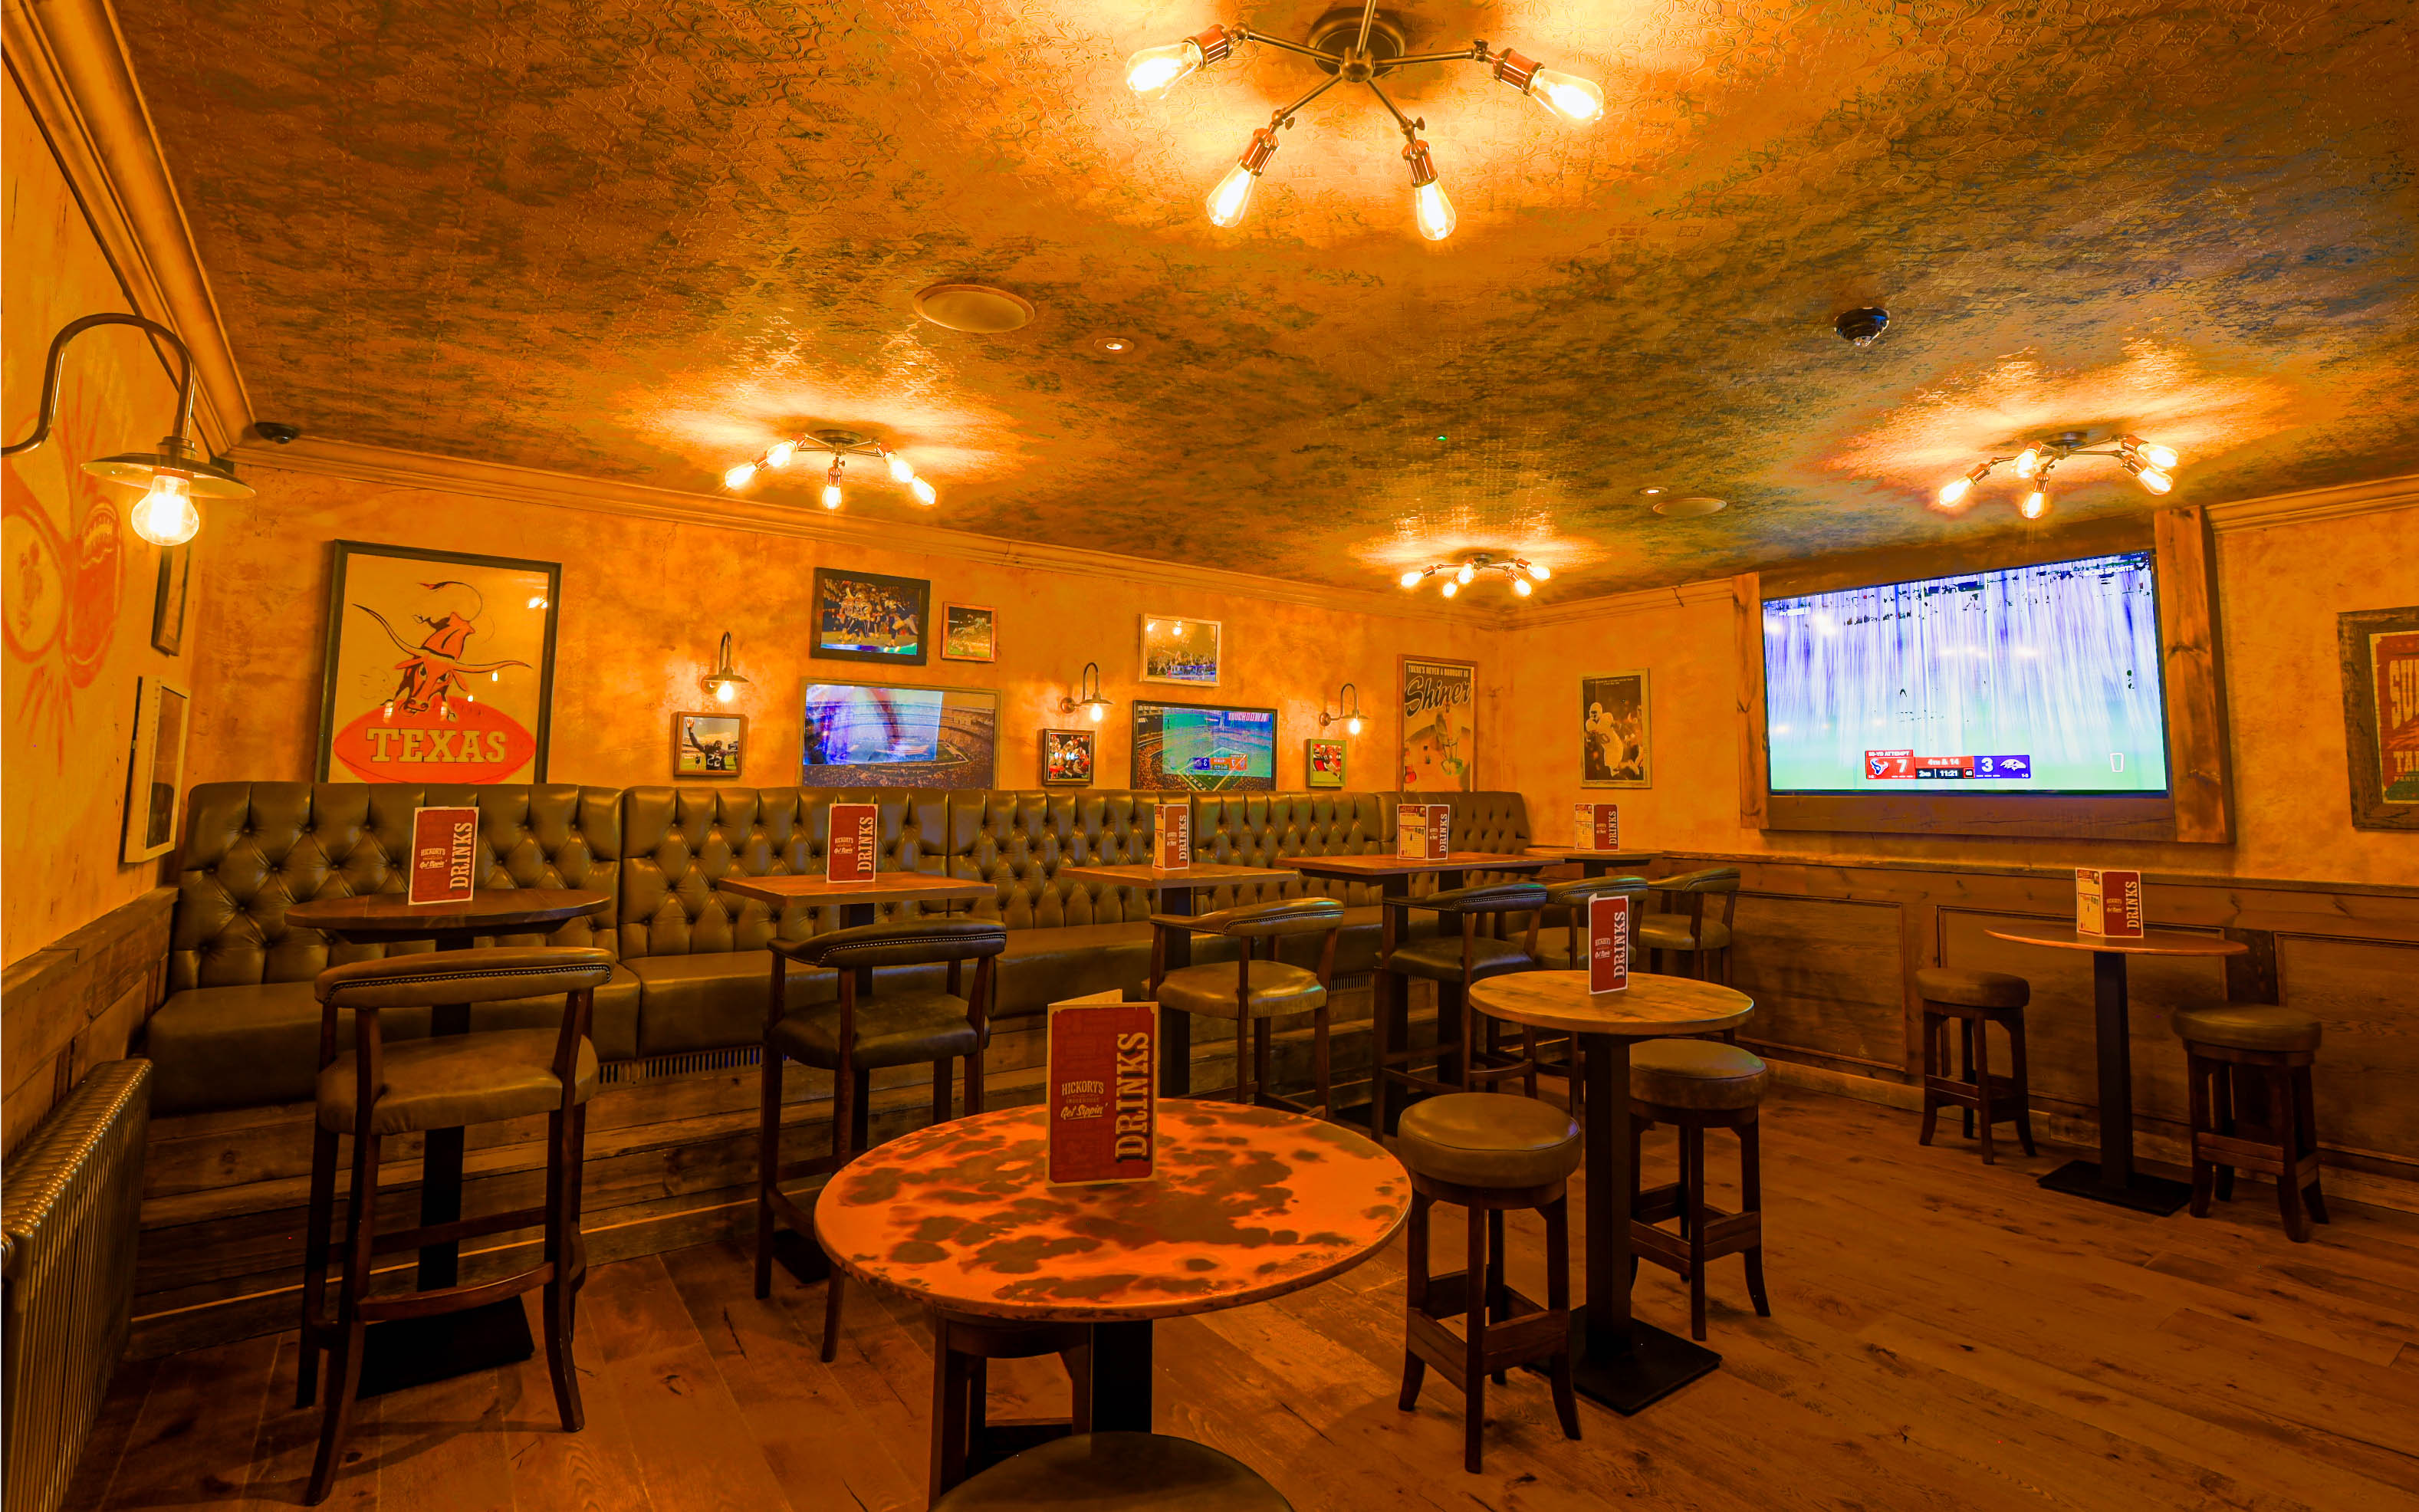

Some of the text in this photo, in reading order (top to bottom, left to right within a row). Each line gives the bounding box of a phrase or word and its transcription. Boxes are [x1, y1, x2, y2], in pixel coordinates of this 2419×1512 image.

[2105, 565, 2135, 574] SPORTS
[1405, 675, 1471, 718] Shiner
[366, 728, 506, 763] TEXAS
[1981, 757, 1993, 772] 3
[1897, 759, 1907, 773] 7
[857, 817, 874, 871] DRINKS
[1178, 814, 1187, 860] DRINKS
[1439, 814, 1448, 853] DRINKS
[1608, 810, 1617, 845] DRINKS
[450, 822, 473, 889] DRINKS
[2125, 881, 2141, 929] DRINKS
[1613, 911, 1625, 978] DRINKS
[1061, 1080, 1104, 1096] HICKORY'S
[1115, 1032, 1149, 1160] DRINKS
[1060, 1105, 1077, 1120] Get
